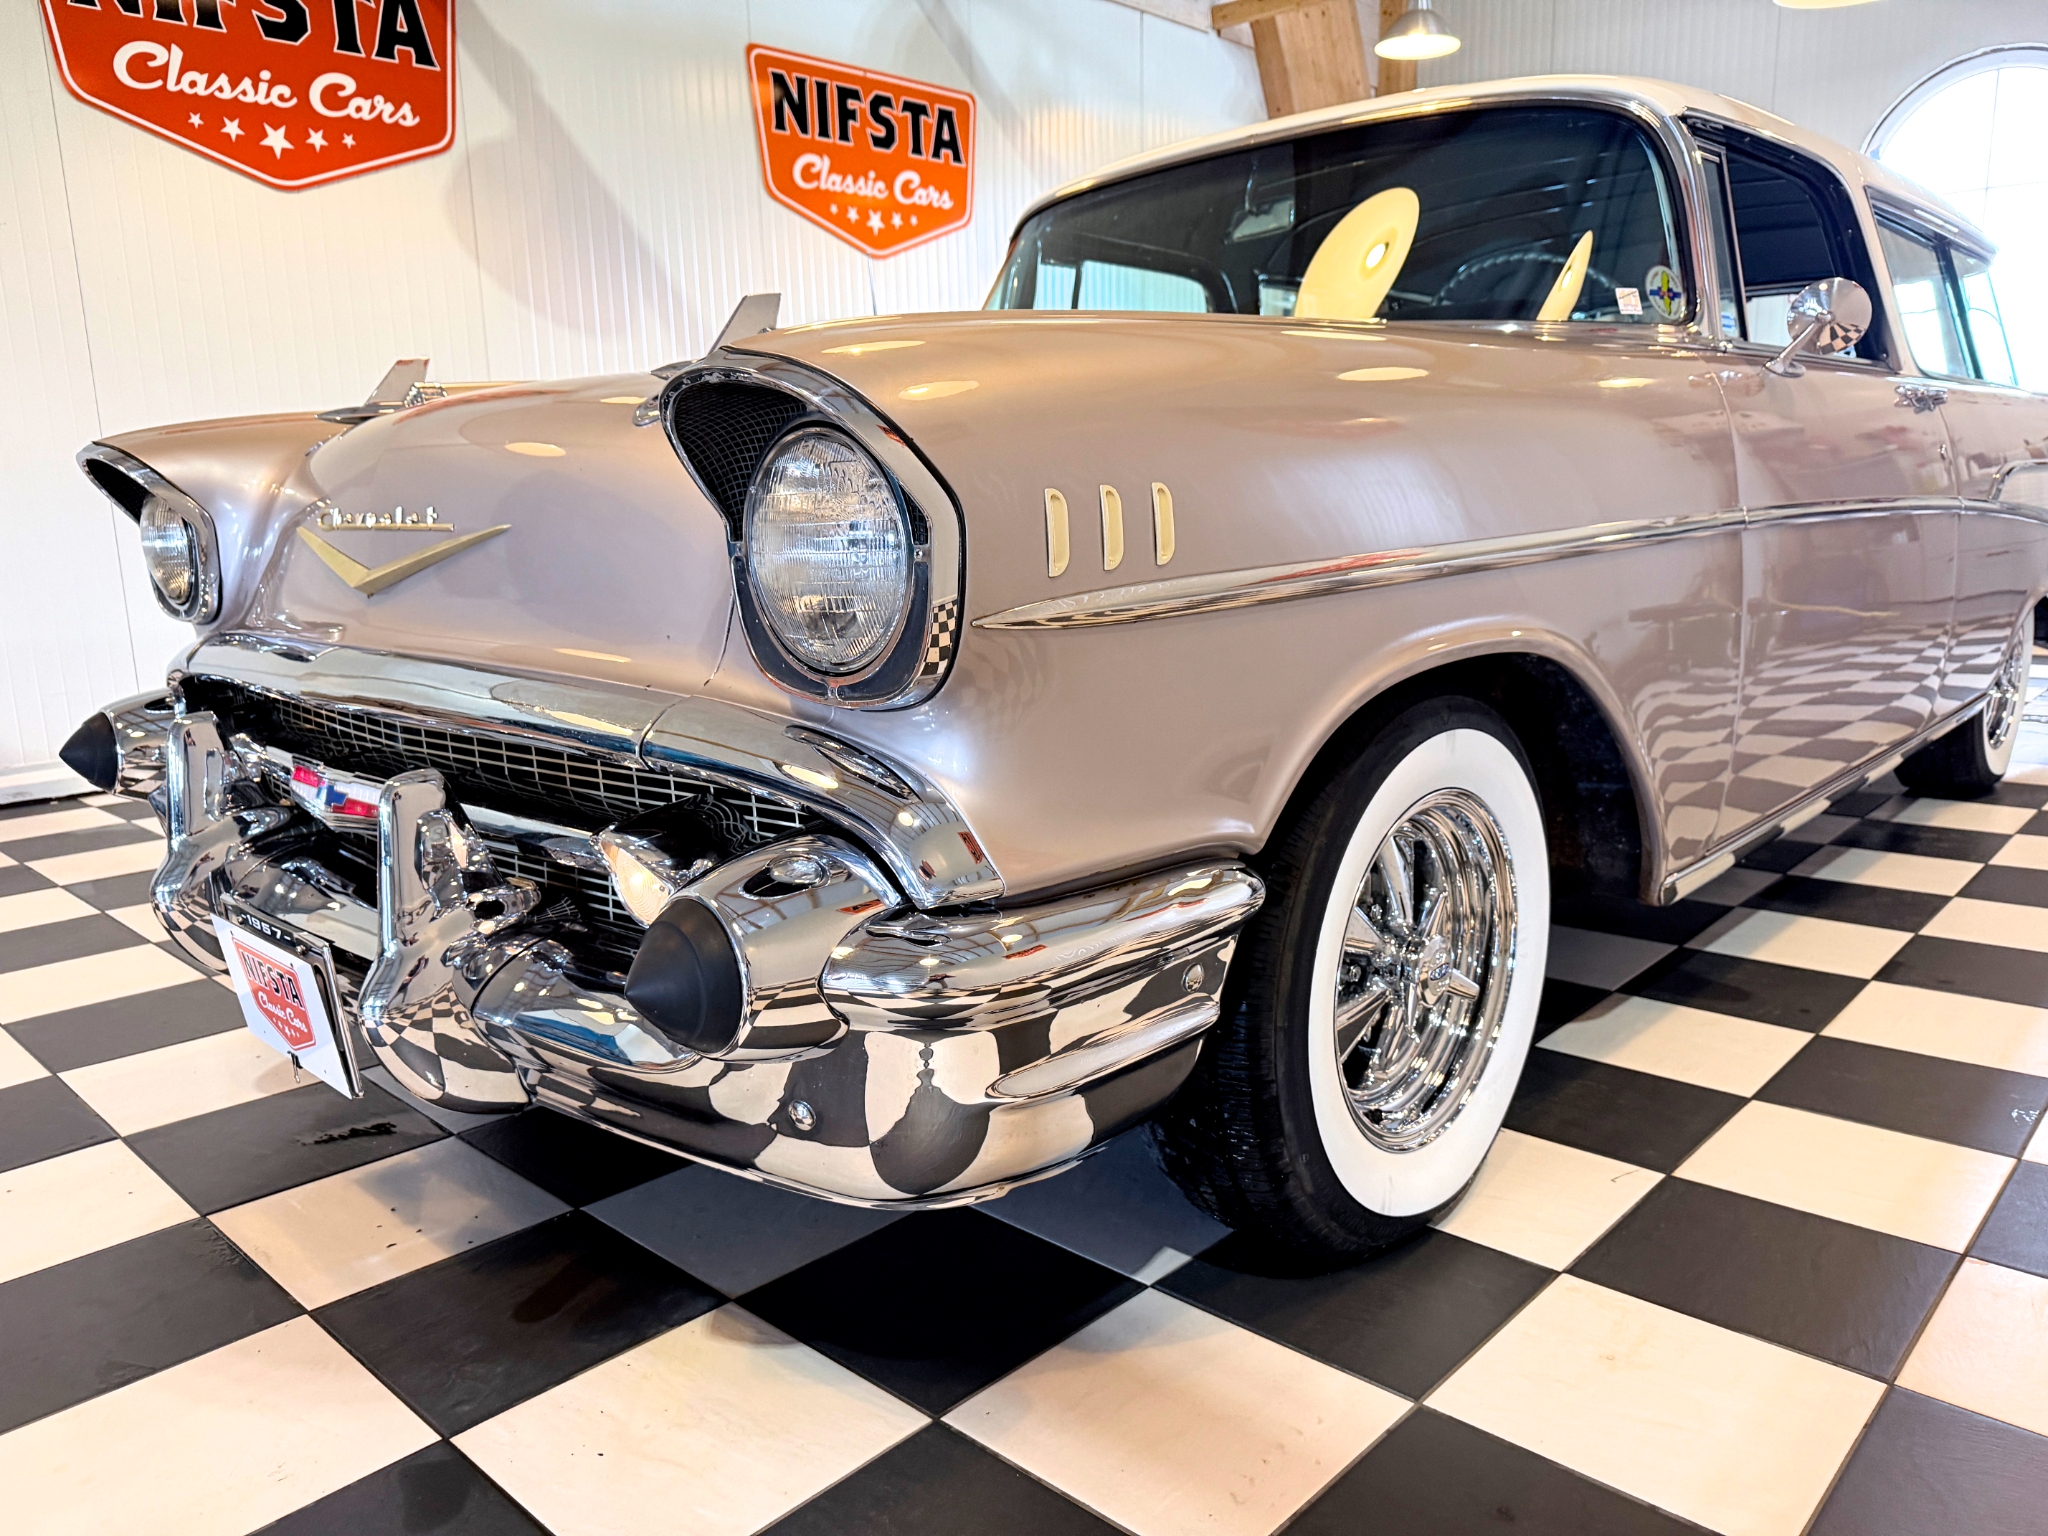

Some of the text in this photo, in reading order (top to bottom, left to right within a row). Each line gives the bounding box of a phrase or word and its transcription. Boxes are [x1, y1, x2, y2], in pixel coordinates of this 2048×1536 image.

[113, 40, 420, 127] Classic Cars
[767, 67, 966, 168] NIFSTA
[792, 153, 954, 210] Classic Cars
[239, 949, 306, 1011] NIFSTA
